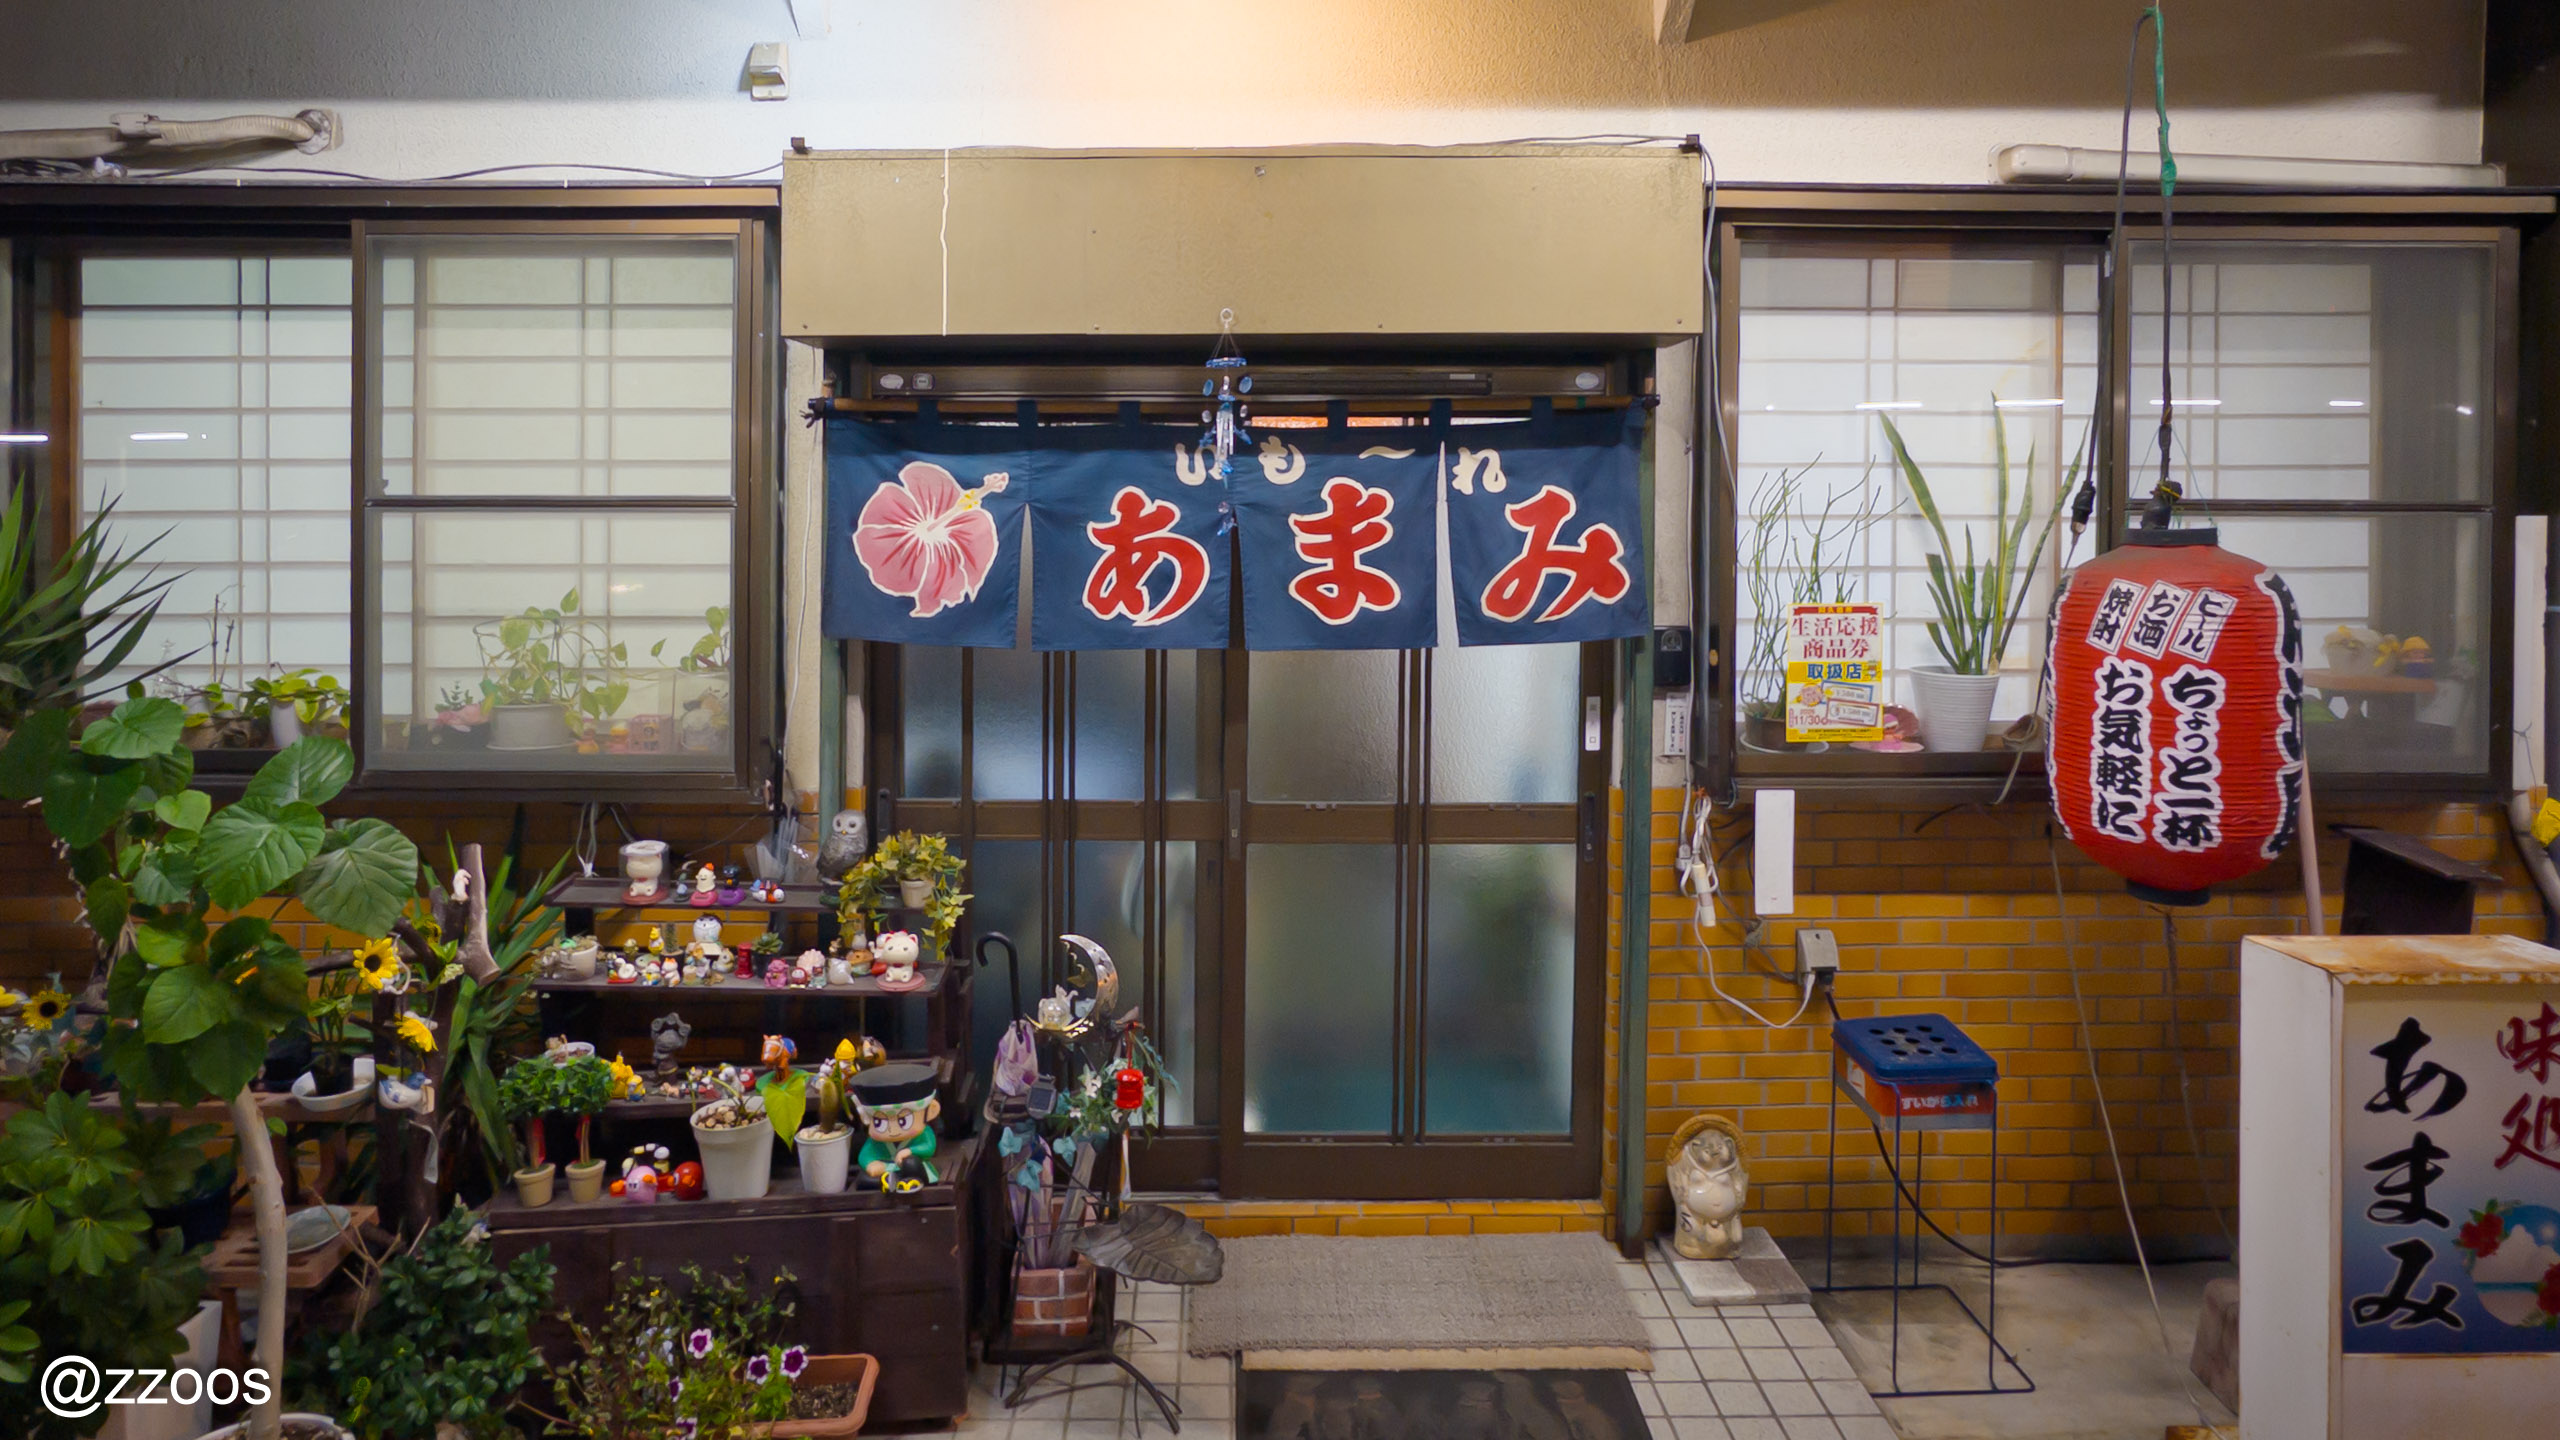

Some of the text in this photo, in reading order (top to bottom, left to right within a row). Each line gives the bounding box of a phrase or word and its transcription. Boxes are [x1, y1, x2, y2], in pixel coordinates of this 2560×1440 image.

[1083, 476, 1631, 628] あまみ
[1792, 616, 1878, 637] 生活応援
[2091, 586, 2135, 646] 焼酎
[2134, 589, 2177, 649] お酒
[2179, 593, 2224, 653] ビール
[1803, 638, 1868, 659] 商品券
[1807, 663, 1862, 680] 取扱店
[2096, 662, 2145, 837] お気軽に
[2161, 671, 2219, 846] ちょっと一杯
[2352, 1016, 2468, 1328] あまみ
